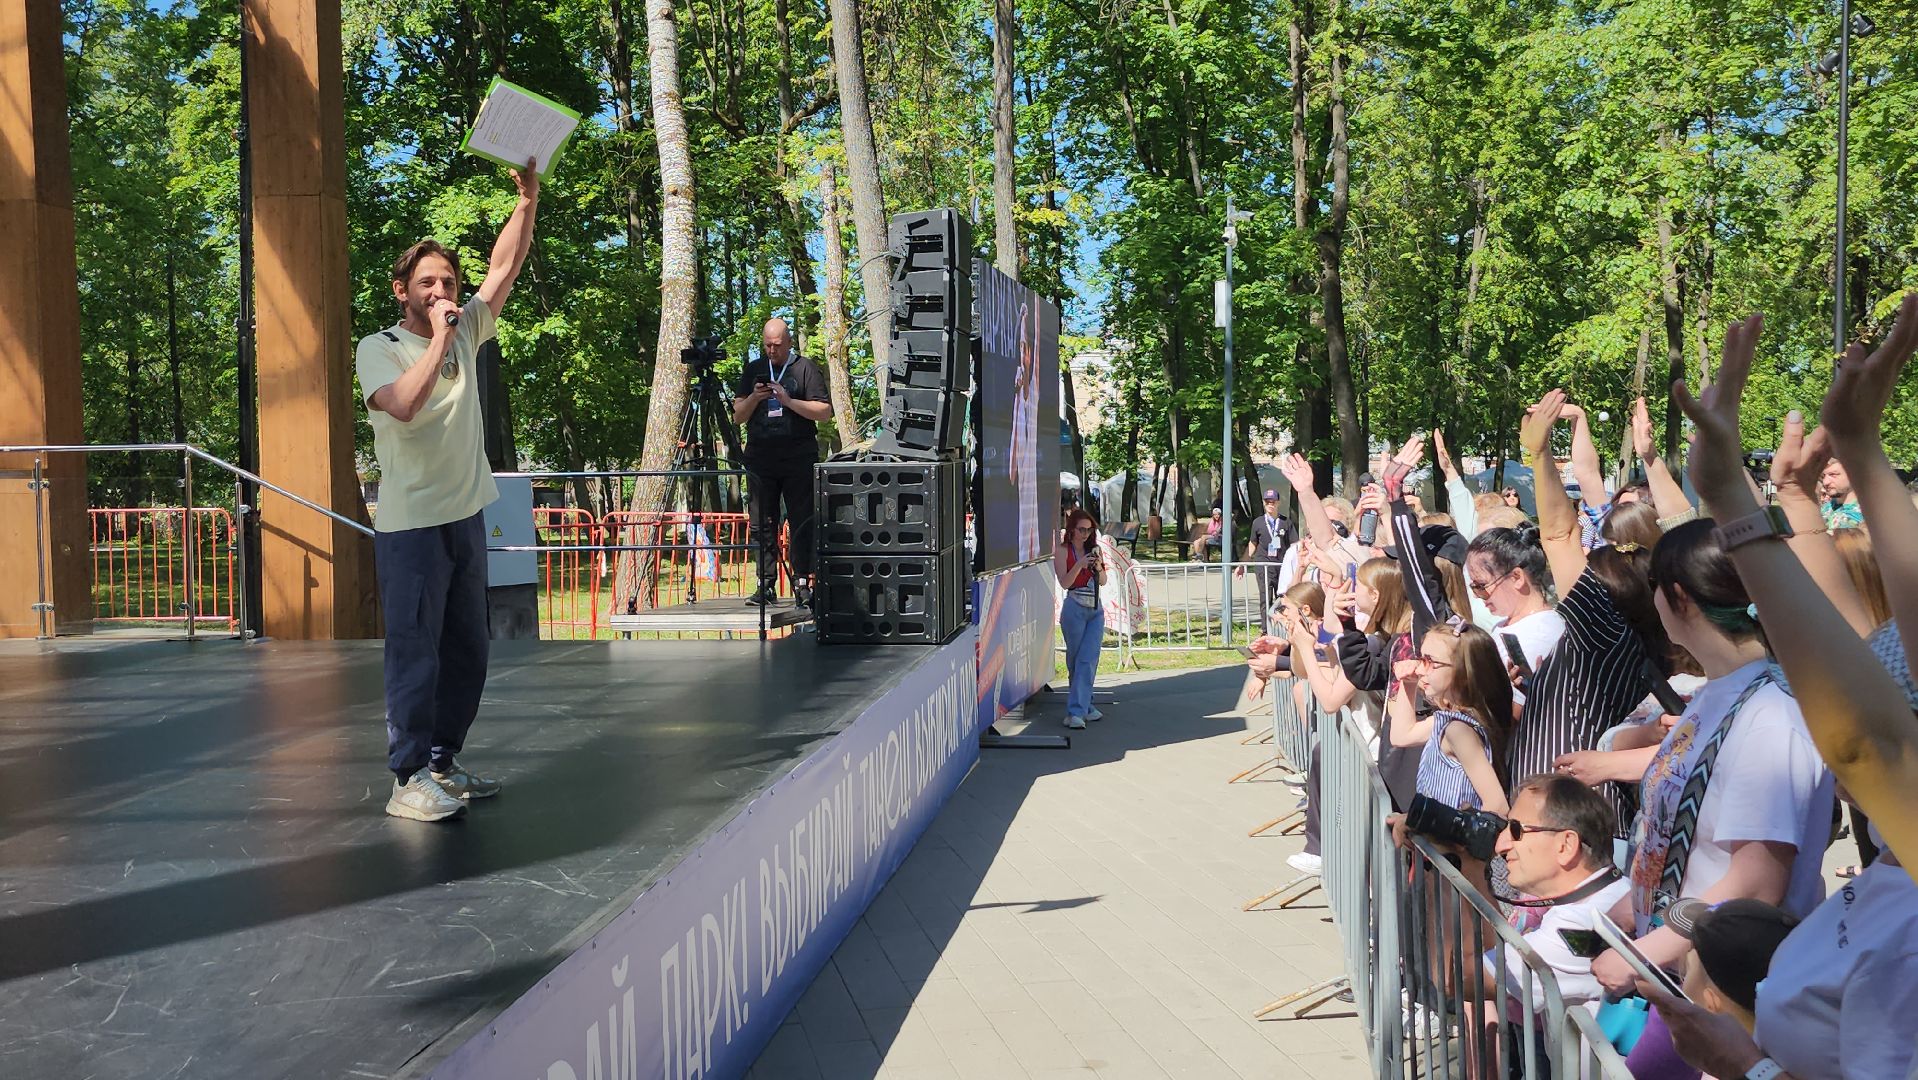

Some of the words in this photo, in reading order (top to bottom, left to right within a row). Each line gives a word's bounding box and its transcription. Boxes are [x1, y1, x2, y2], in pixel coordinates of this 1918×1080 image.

[660, 877, 749, 1080] ПАРК!
[760, 752, 854, 998] ВЫБИРАЙ
[914, 658, 959, 798] ВЫБИРАЙ
